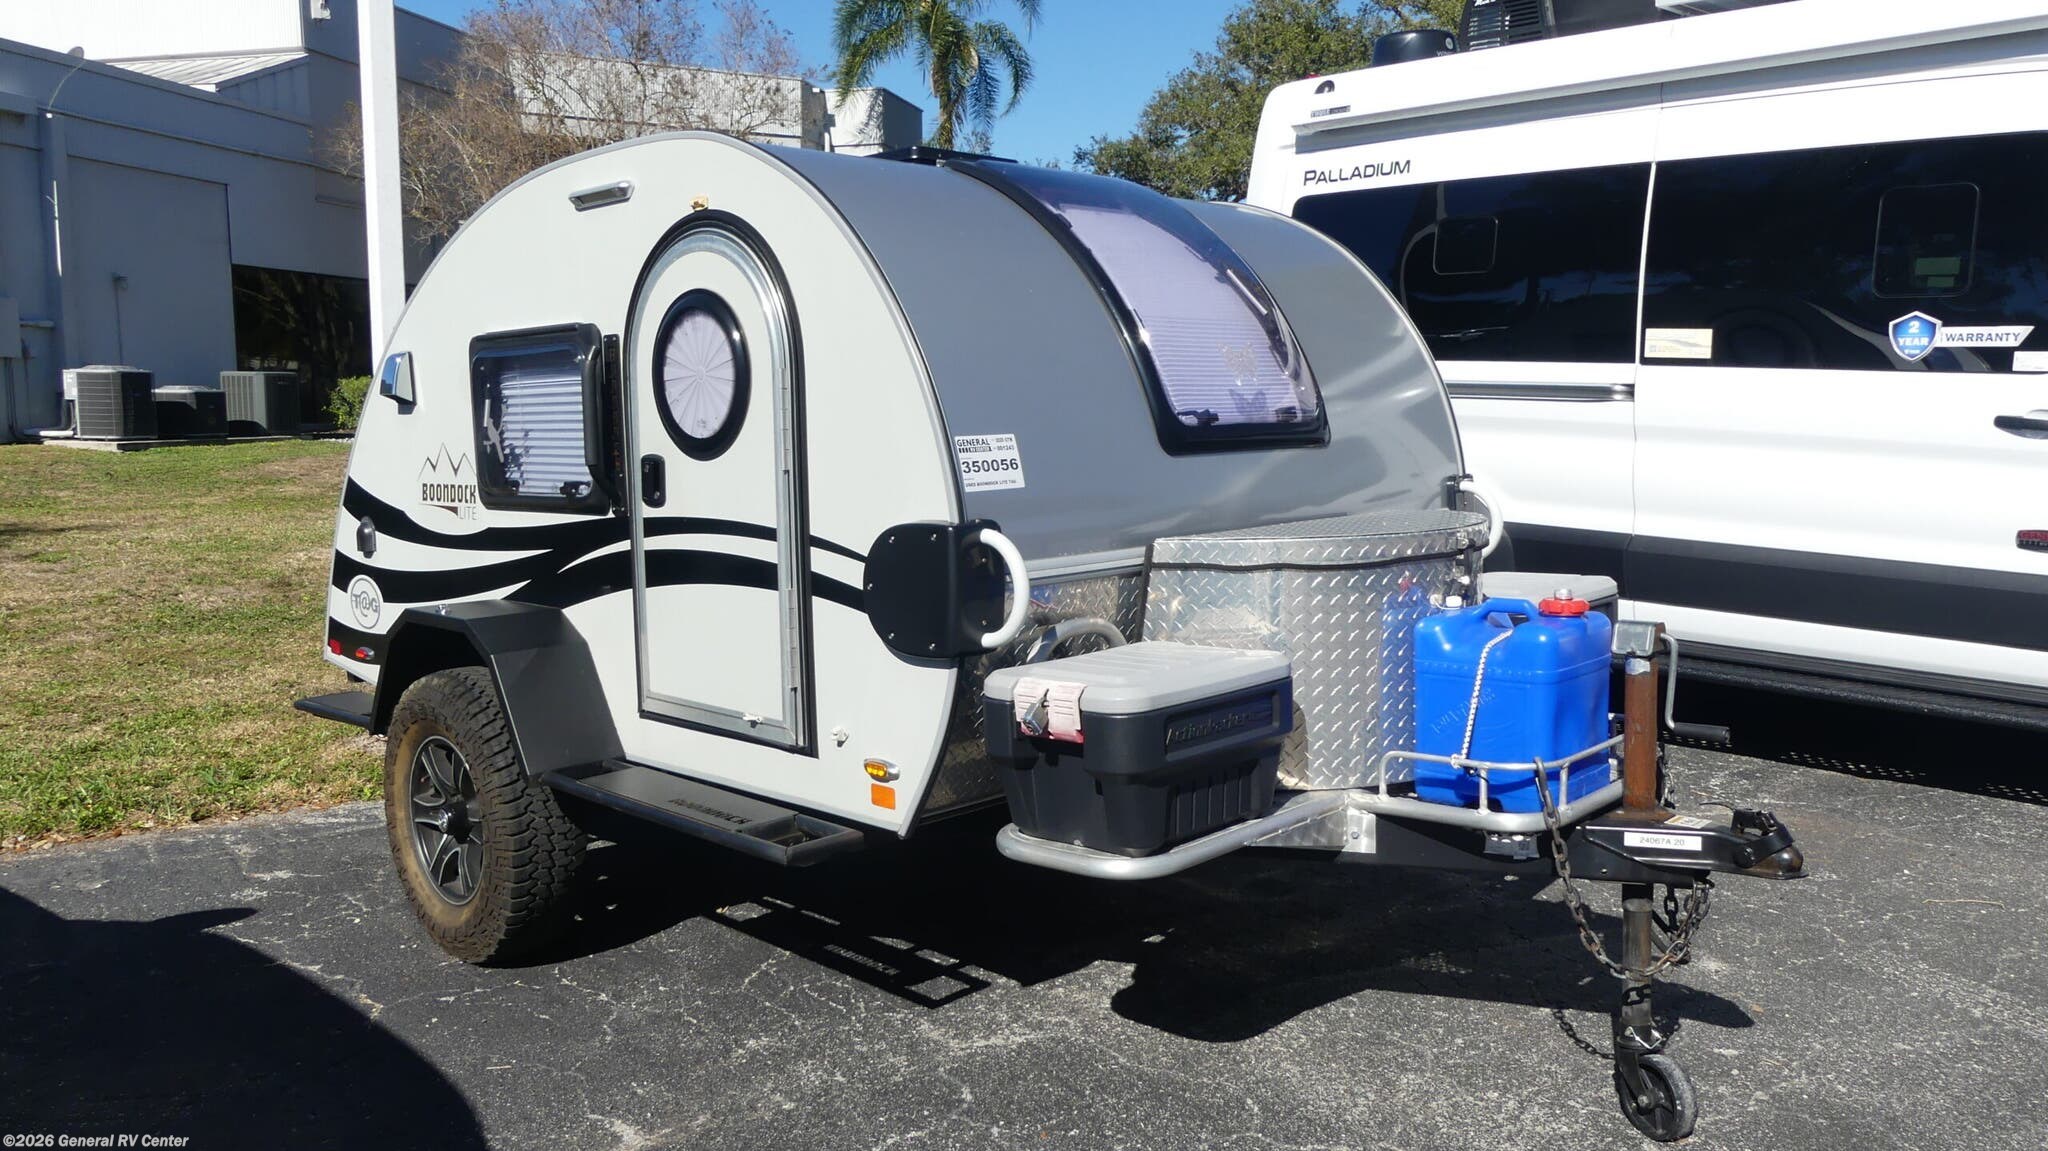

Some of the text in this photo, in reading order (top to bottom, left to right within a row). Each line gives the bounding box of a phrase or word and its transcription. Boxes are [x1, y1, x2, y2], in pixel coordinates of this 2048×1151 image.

[1303, 160, 1411, 186] PALLADIUM
[1908, 321, 1920, 334] 2
[1898, 337, 1929, 346] YEAR
[1945, 332, 2021, 343] WARRANTY
[957, 438, 990, 447] GENERAL
[962, 458, 1019, 474] 350056
[422, 483, 476, 504] BOONDOCK
[459, 506, 477, 520] LITE
